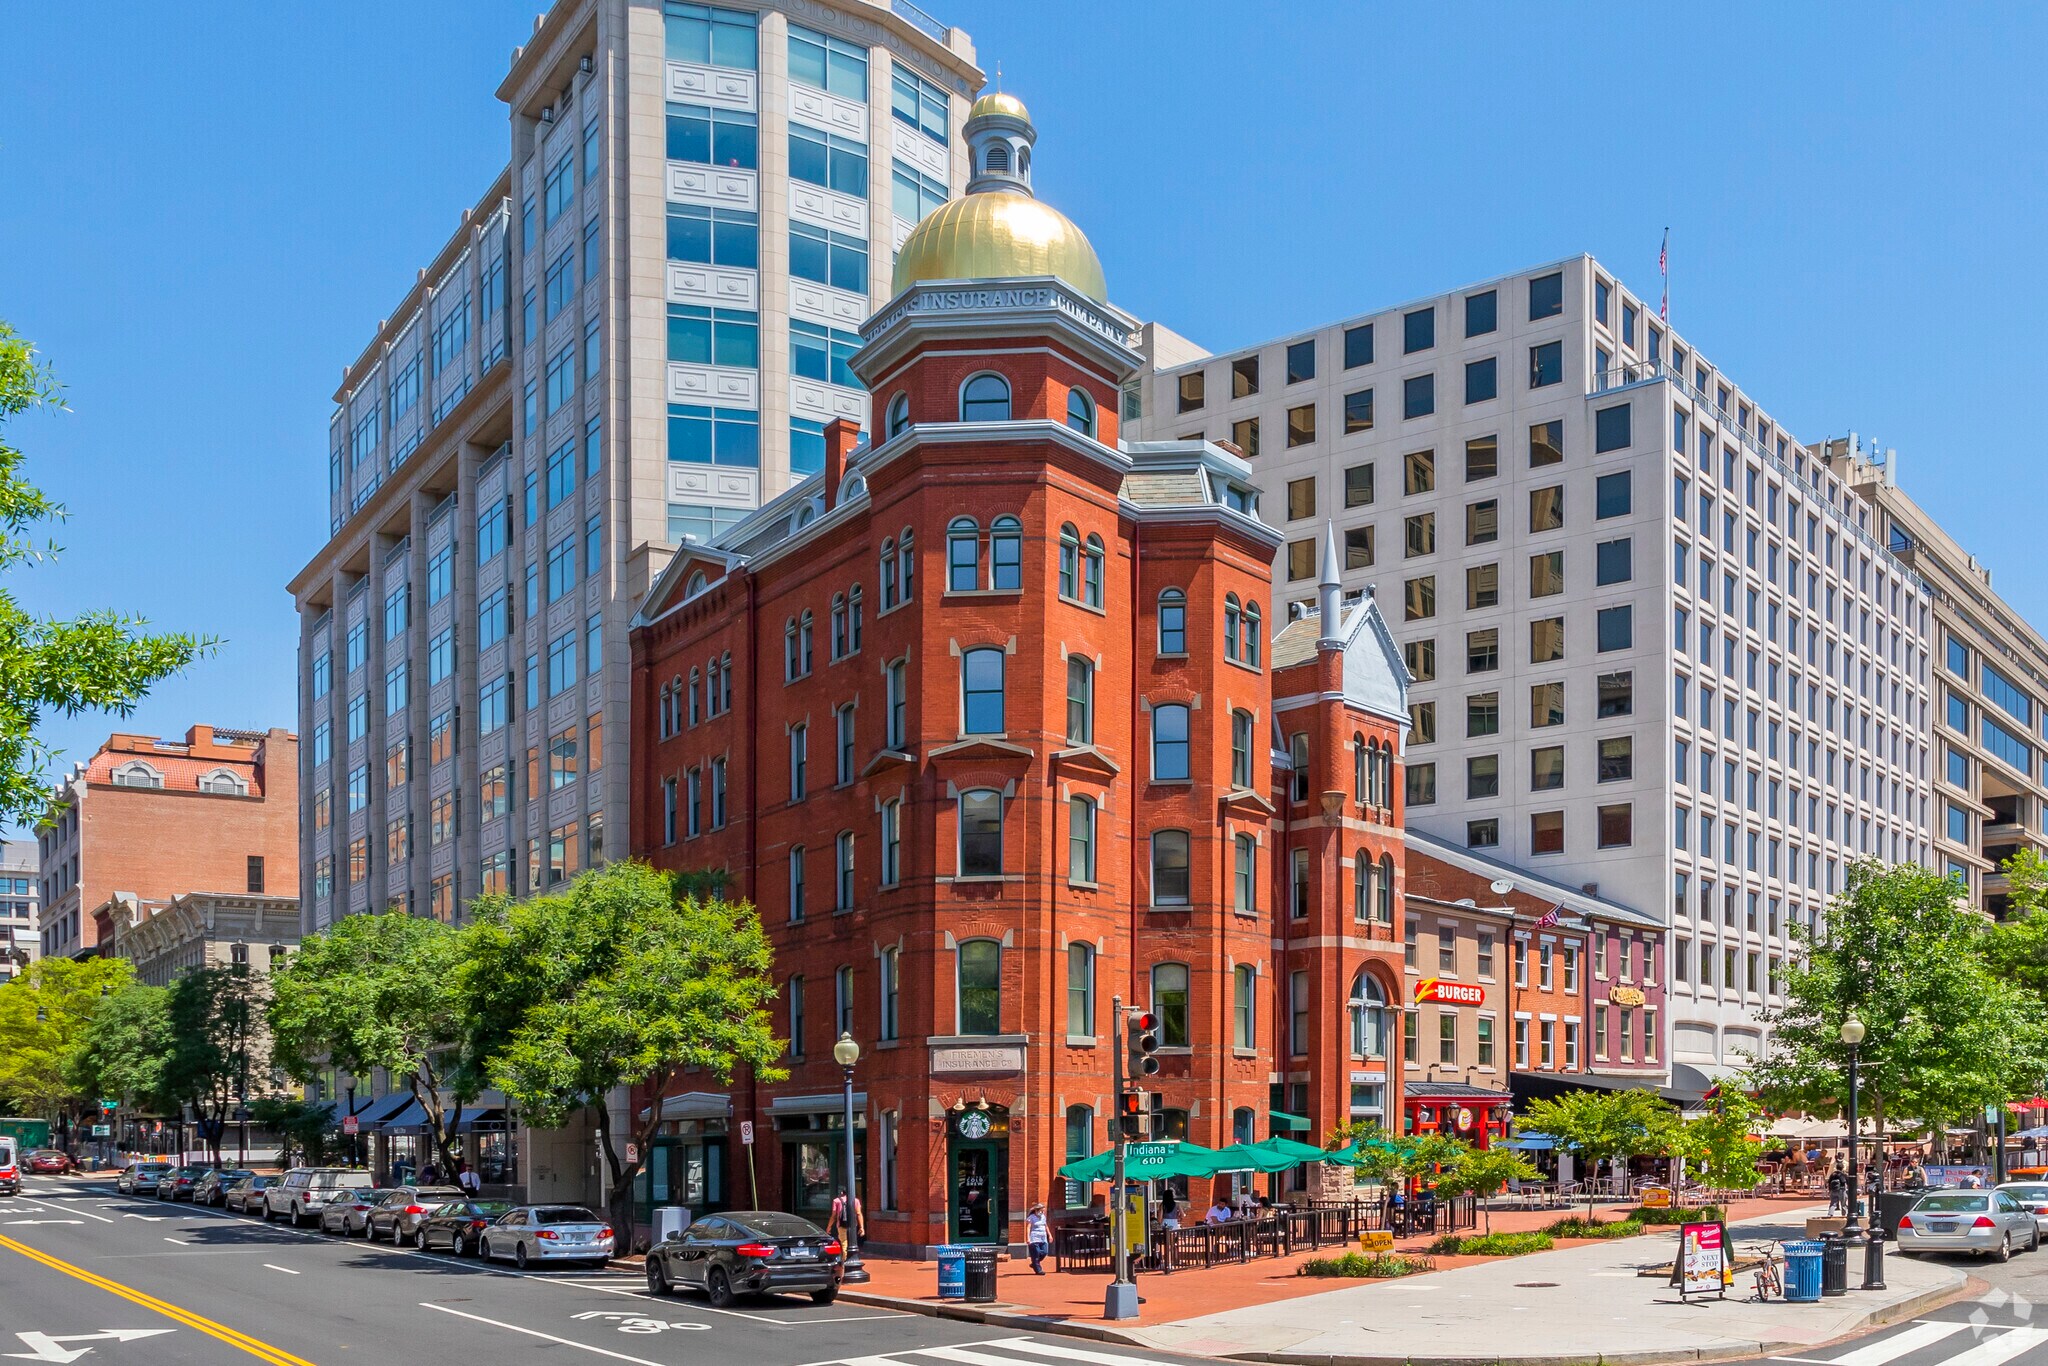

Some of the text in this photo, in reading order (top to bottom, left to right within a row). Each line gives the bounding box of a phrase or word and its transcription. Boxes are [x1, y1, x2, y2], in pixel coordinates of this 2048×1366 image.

[922, 289, 1048, 310] INSURANCE
[1057, 295, 1124, 342] COMPANY
[1415, 977, 1481, 1004] Z-BURGER
[952, 1050, 1004, 1059] FIREMEN'S
[942, 1060, 997, 1068] INSURANCE
[1130, 1144, 1166, 1155] Indiana
[1142, 1156, 1164, 1165] 600
[1374, 1239, 1393, 1247] OPEN
